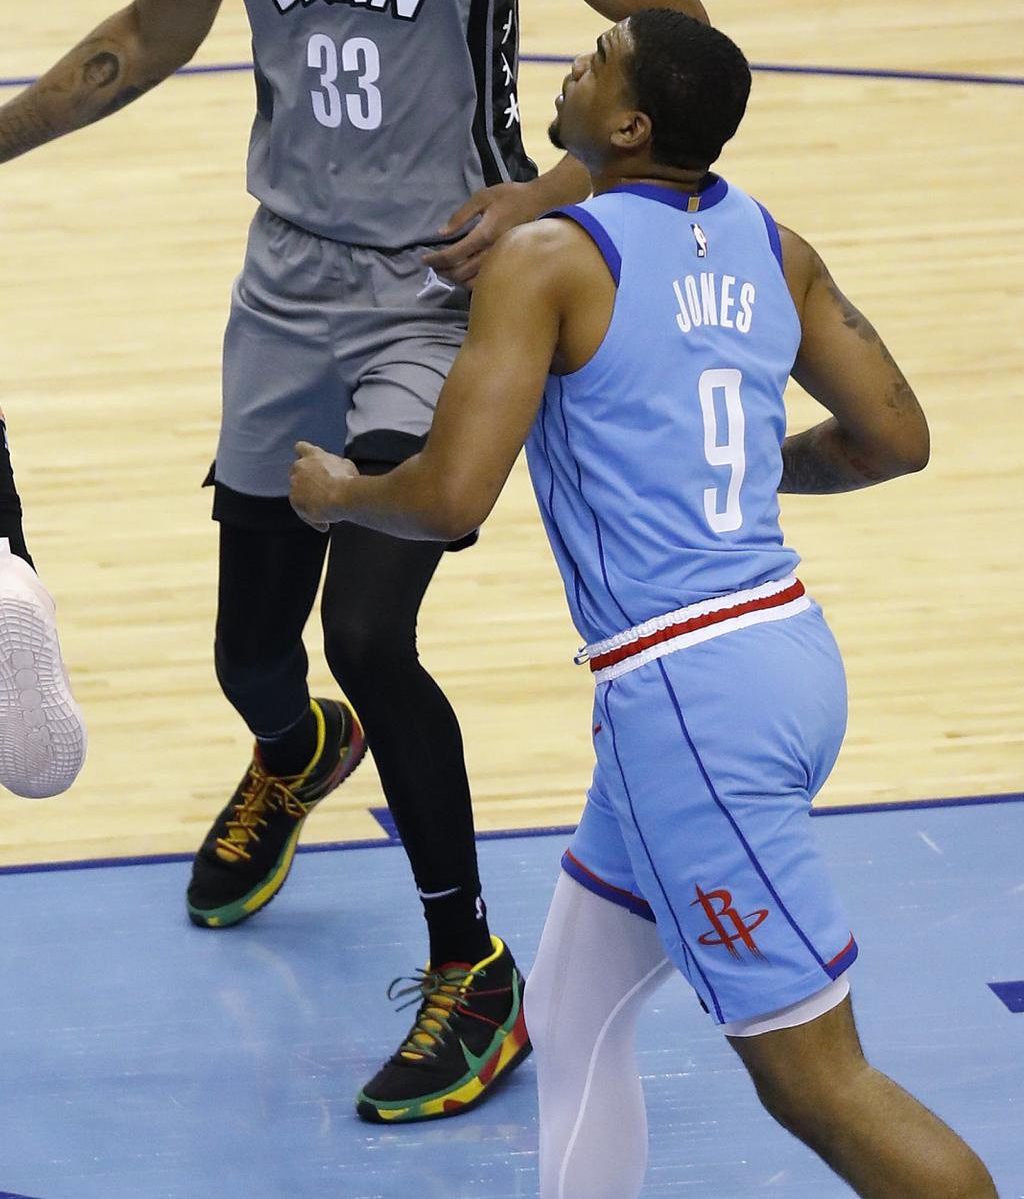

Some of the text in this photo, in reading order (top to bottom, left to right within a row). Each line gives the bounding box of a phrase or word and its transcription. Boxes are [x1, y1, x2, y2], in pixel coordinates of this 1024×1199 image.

[307, 33, 382, 130] 33
[672, 272, 756, 333] JONES
[698, 368, 746, 533] 9
